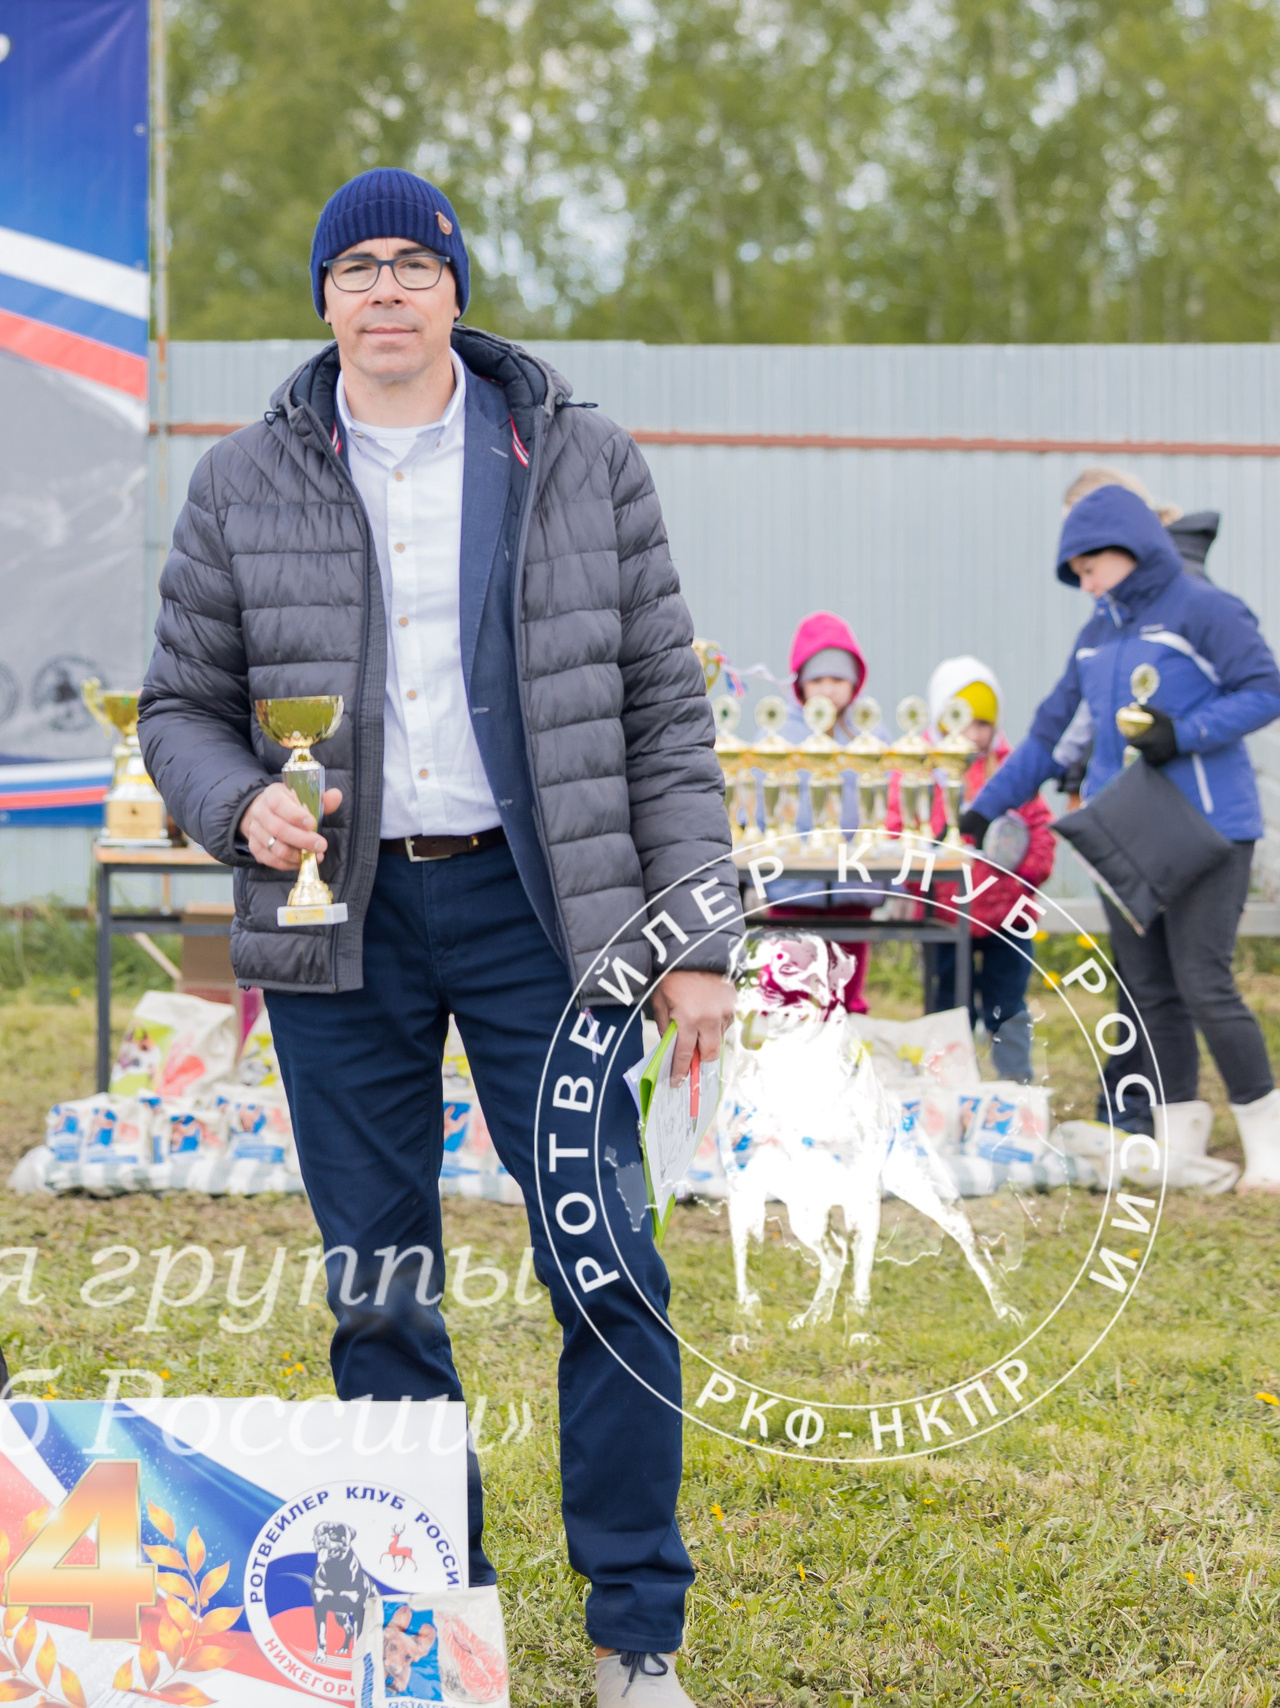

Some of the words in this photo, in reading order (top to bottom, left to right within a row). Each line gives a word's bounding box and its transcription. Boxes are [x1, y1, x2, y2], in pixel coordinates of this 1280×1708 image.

[4, 1458, 158, 1642] 4
[250, 1490, 330, 1604] РОТВЕЙЛЕР
[345, 1486, 406, 1511] КЛУБ
[263, 1636, 355, 1697] НИЖЕГОР
